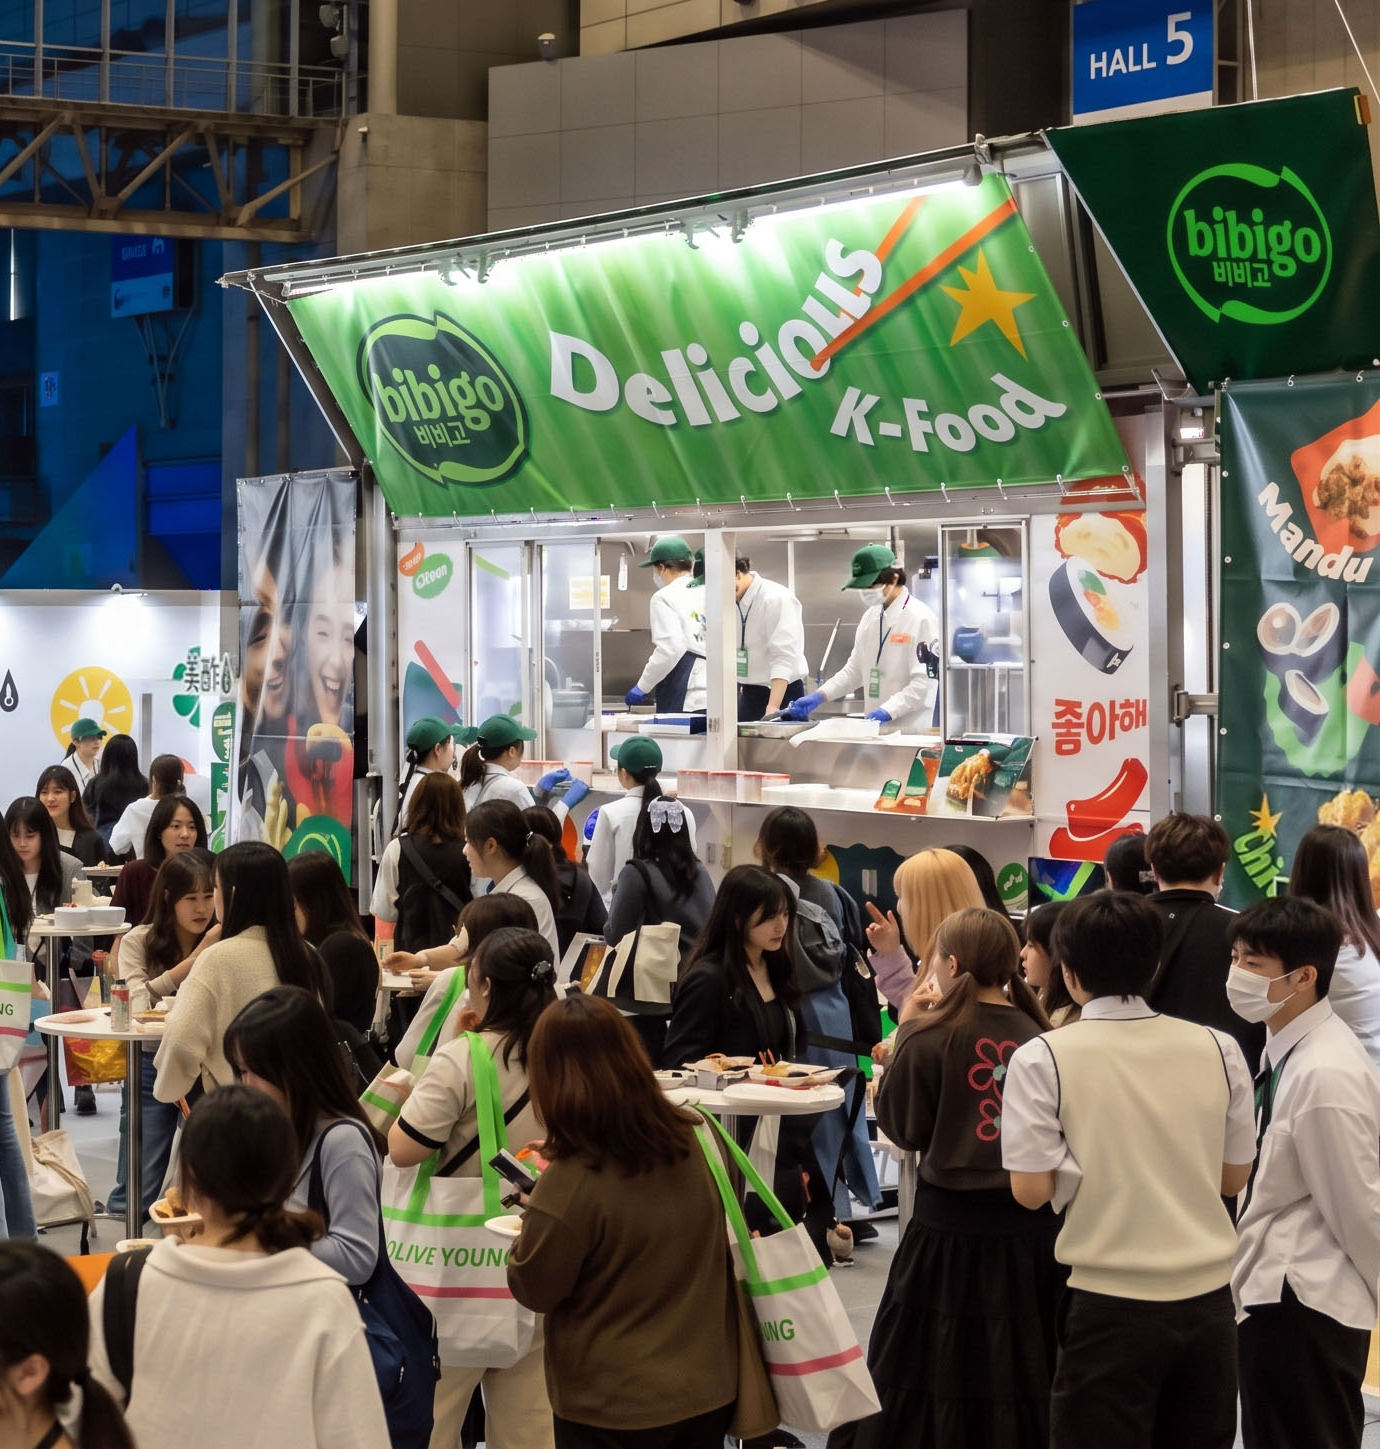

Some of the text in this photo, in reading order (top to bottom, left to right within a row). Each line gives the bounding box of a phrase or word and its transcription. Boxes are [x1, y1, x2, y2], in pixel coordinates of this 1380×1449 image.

[1089, 11, 1194, 80] HALL 5
[1184, 205, 1321, 278] bibigo
[1212, 261, 1271, 288] 비비고
[550, 237, 883, 427] Delicious
[372, 363, 505, 432] bibigo
[829, 372, 1068, 453] K-Food
[413, 421, 471, 449] 비비고
[1258, 481, 1374, 583] Mandu
[1051, 698, 1147, 756] 좋아해
[386, 1240, 436, 1265] OLIVE
